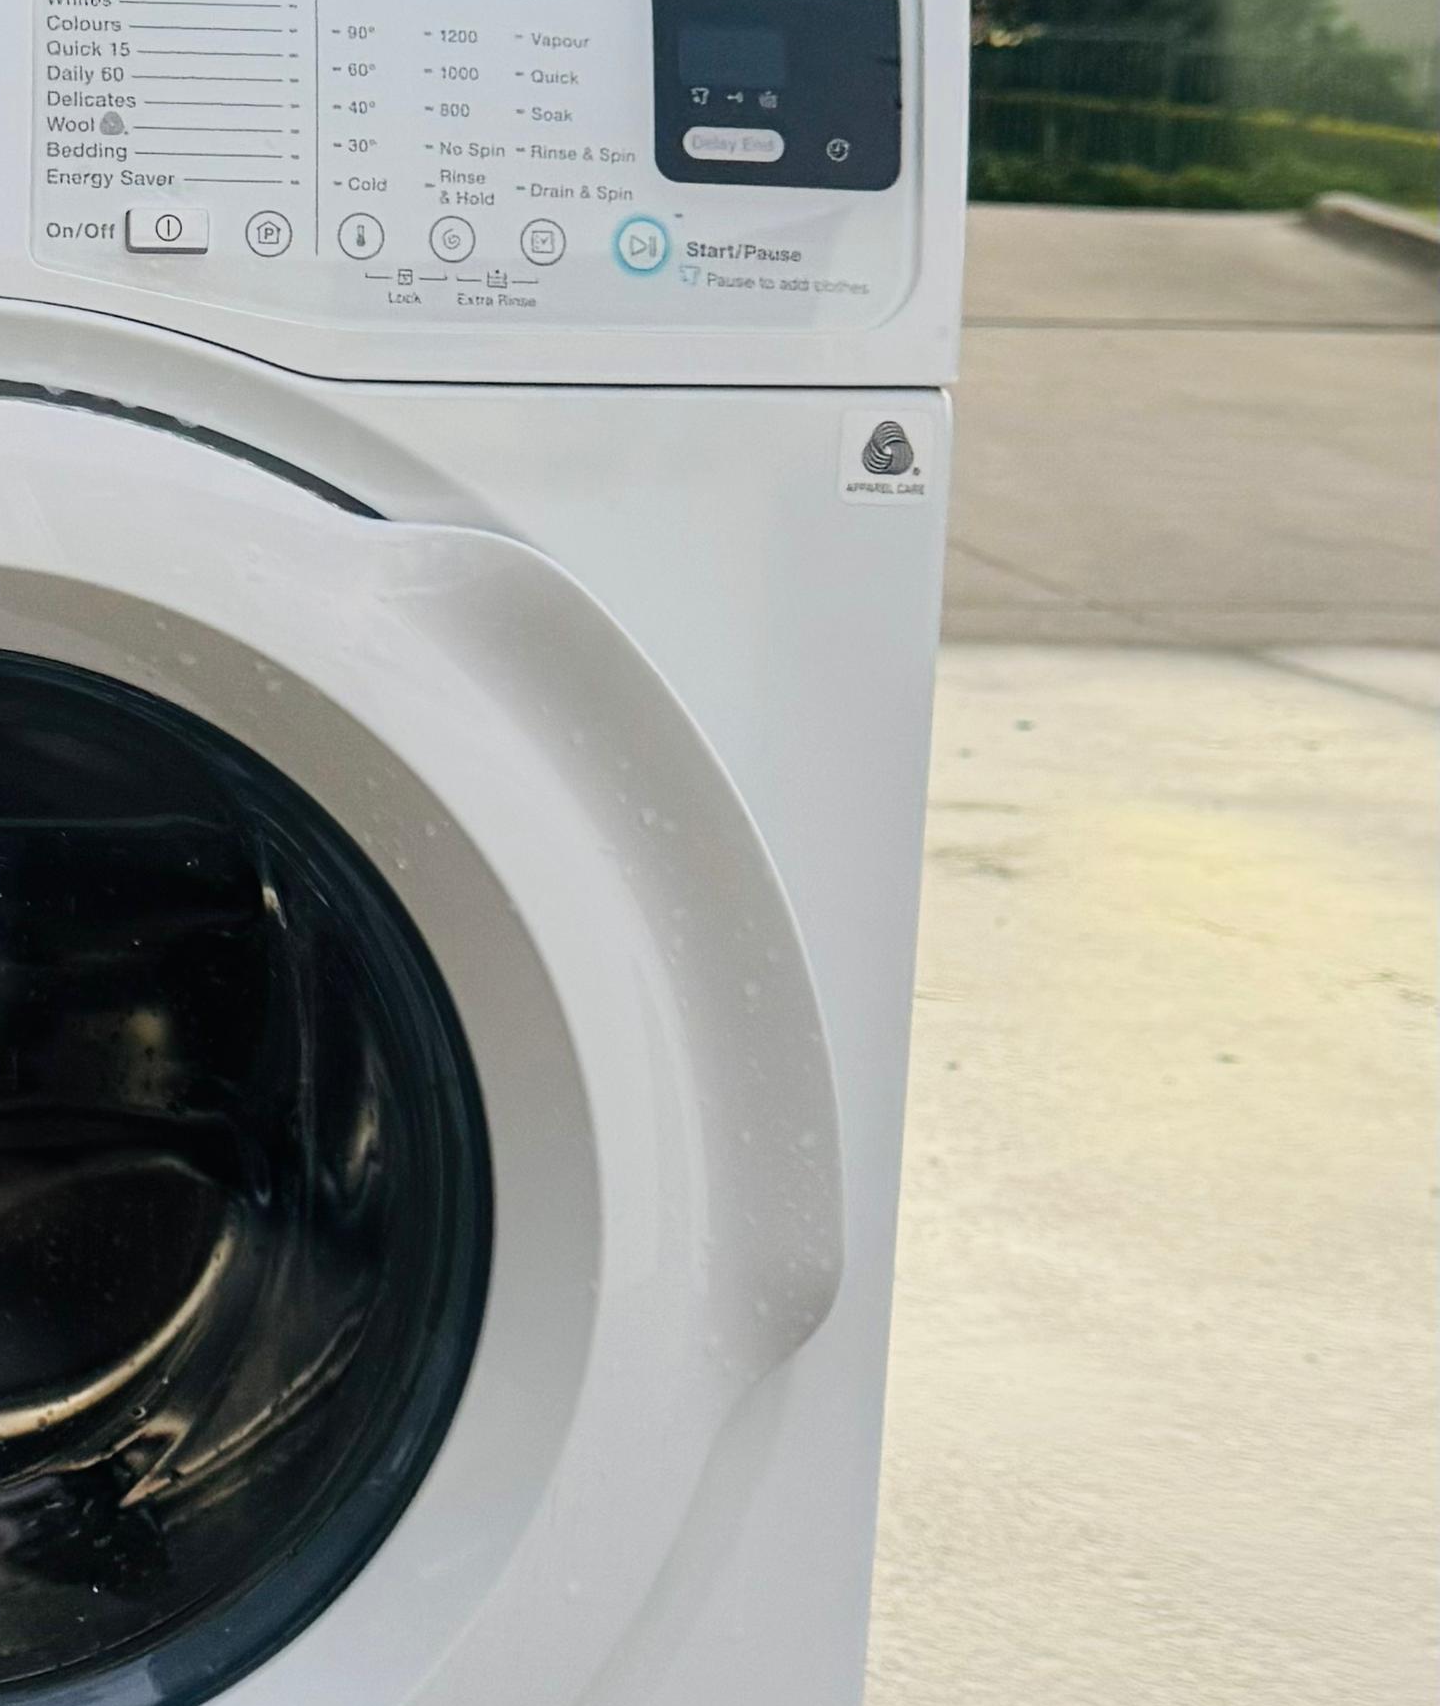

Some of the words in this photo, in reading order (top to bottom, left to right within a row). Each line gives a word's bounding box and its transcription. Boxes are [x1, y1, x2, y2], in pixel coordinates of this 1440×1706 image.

[47, 15, 122, 32] Colours
[440, 29, 478, 44] 1200
[531, 32, 591, 50] Vapour
[47, 40, 102, 57] Quick
[110, 42, 131, 57] 15
[47, 65, 94, 84] Daily
[101, 67, 124, 83] 60
[441, 67, 479, 81] 1000
[531, 71, 579, 86] Quick
[47, 91, 137, 108] Delicates
[440, 104, 470, 118] 800
[531, 107, 573, 122] Soak
[47, 116, 95, 133] Wool
[47, 142, 128, 161] Bedding
[439, 142, 464, 156] No
[468, 143, 505, 159] Spin
[530, 145, 578, 161] Rinse
[582, 147, 594, 161] &
[599, 149, 636, 164] Spin
[47, 169, 113, 189] Energy
[120, 170, 175, 187] Saver
[348, 177, 387, 192] Cold
[439, 170, 486, 185] Rinse
[439, 192, 452, 205] &
[456, 191, 495, 206] Hold
[530, 184, 575, 199] Drain
[579, 186, 591, 200] &
[596, 187, 633, 202] Spin
[47, 223, 116, 240] On/Off
[686, 241, 802, 262] Start/Pause
[707, 273, 755, 289] Pause
[759, 277, 774, 290] to
[389, 291, 421, 305] Lock
[457, 292, 494, 307] Extra
[499, 294, 536, 307] Rinse
